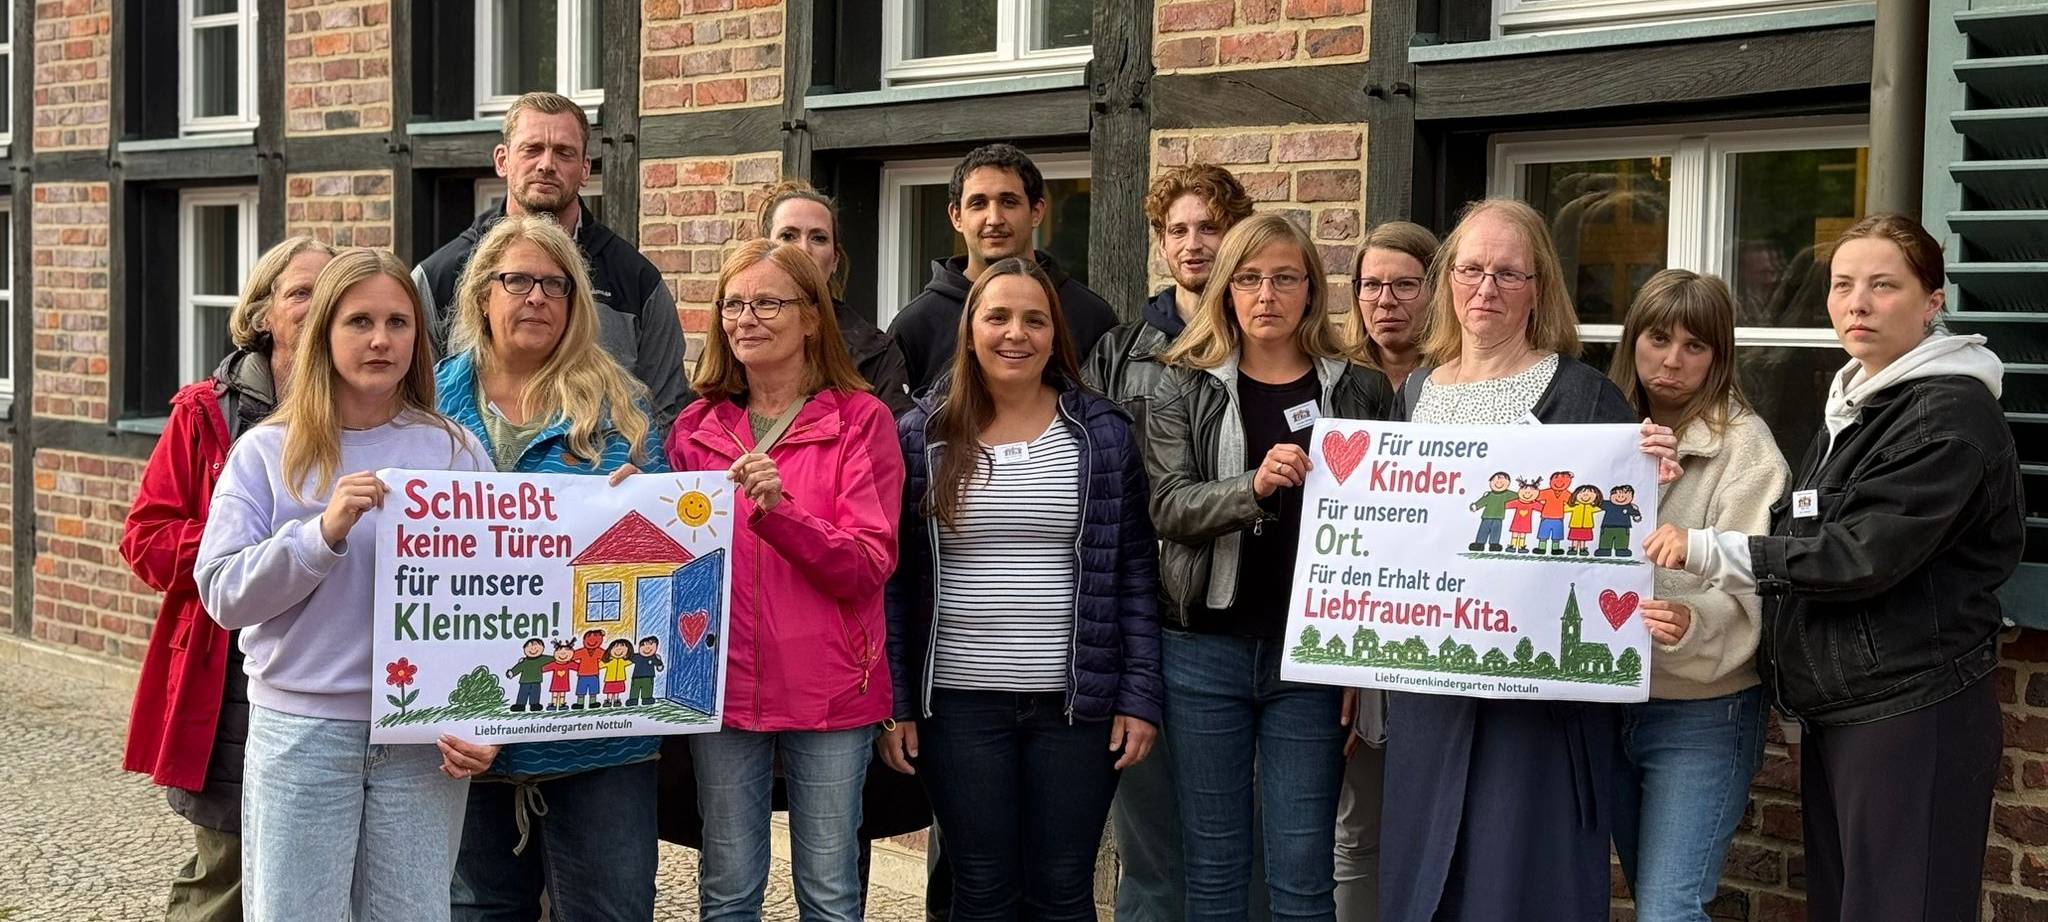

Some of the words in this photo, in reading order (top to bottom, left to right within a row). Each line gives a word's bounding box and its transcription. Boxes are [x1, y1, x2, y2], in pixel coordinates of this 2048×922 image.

[1377, 432, 1413, 457] Für
[1418, 438, 1489, 459] unsere
[1369, 460, 1466, 495] Kinder.
[404, 479, 558, 520] Schließt
[1316, 498, 1349, 522] Für
[1353, 504, 1429, 524] unseren
[396, 524, 477, 559] keine
[488, 525, 573, 559] Türen
[1315, 524, 1370, 557] Ort.
[395, 564, 440, 596] für
[450, 571, 544, 595] unsere
[1308, 564, 1337, 586] Für
[1341, 565, 1372, 588] den
[1377, 567, 1431, 591] Erhalt
[1435, 571, 1466, 592] der
[394, 601, 561, 641] Kleinsten!
[1303, 588, 1519, 634] Liebfrauen-Kita.
[1374, 672, 1495, 693] Liebfrauenkindergarten
[1497, 682, 1540, 694] Nottuln
[474, 723, 594, 736] Liebfrauenkindergarten
[596, 719, 633, 731] Nottuln
